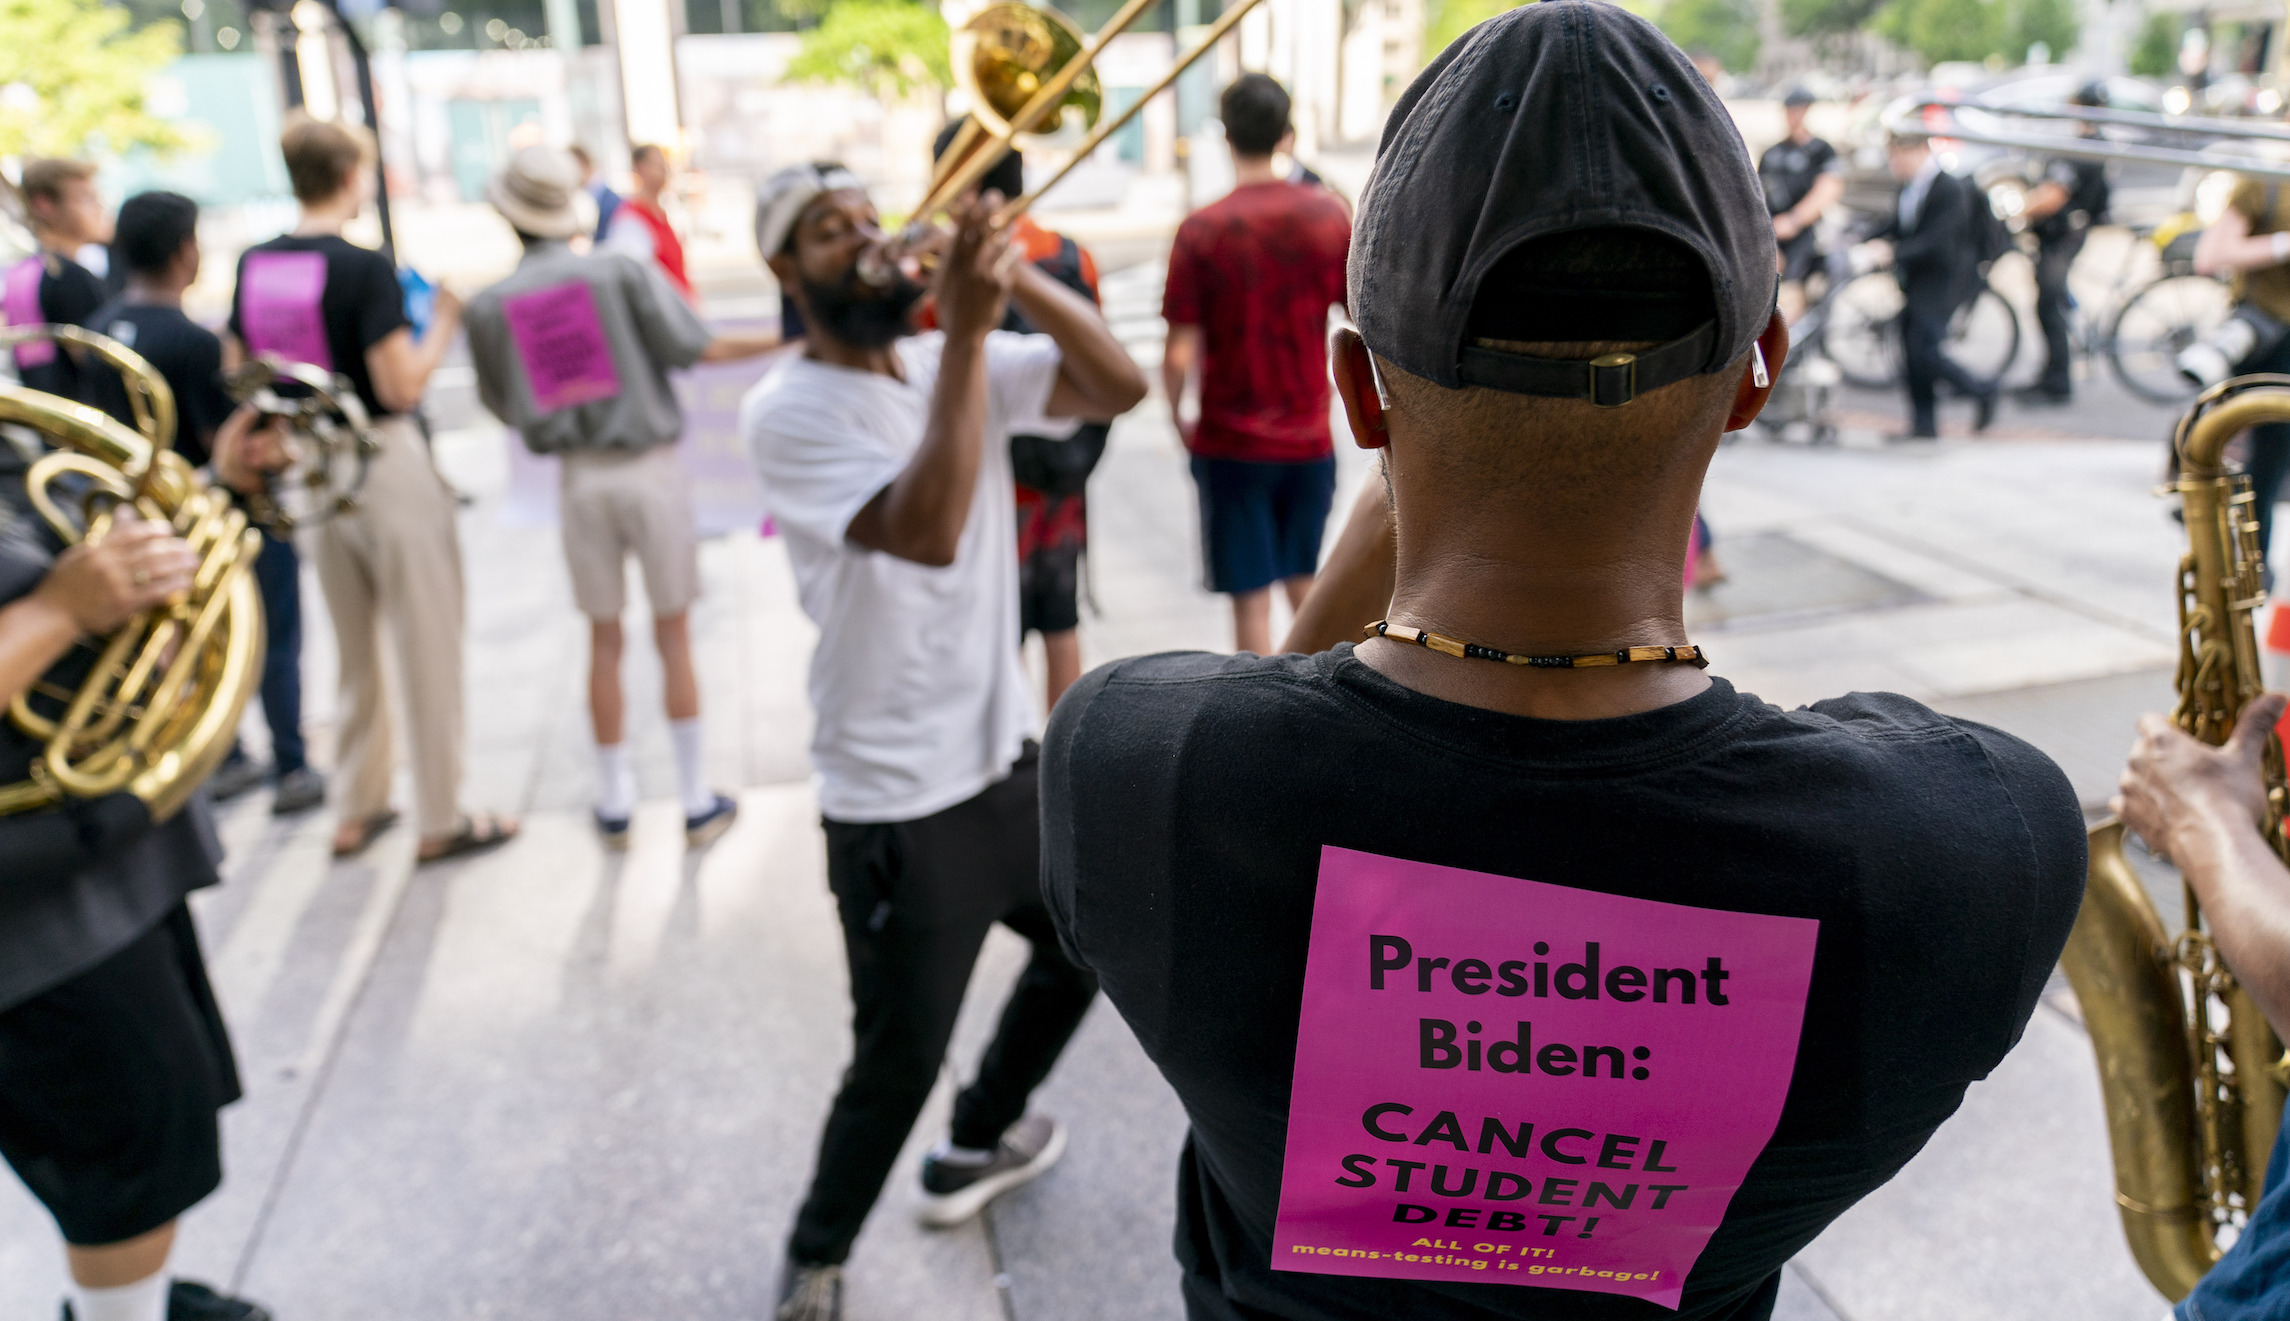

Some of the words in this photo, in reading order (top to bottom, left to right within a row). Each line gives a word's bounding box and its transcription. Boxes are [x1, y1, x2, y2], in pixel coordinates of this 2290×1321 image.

[1369, 934, 1730, 1006] President
[1418, 1018, 1651, 1081] Biden:
[1361, 1102, 1678, 1173] CANCEL
[1334, 1153, 1689, 1211] STUDENT
[1391, 1203, 1601, 1240] DEBT!
[1411, 1237, 1463, 1251] ALL
[1472, 1242, 1512, 1255] OF
[1519, 1246, 1556, 1259] IT!
[1291, 1244, 1488, 1271] means-testing
[1497, 1258, 1519, 1270] is
[1527, 1263, 1660, 1282] garbage!
